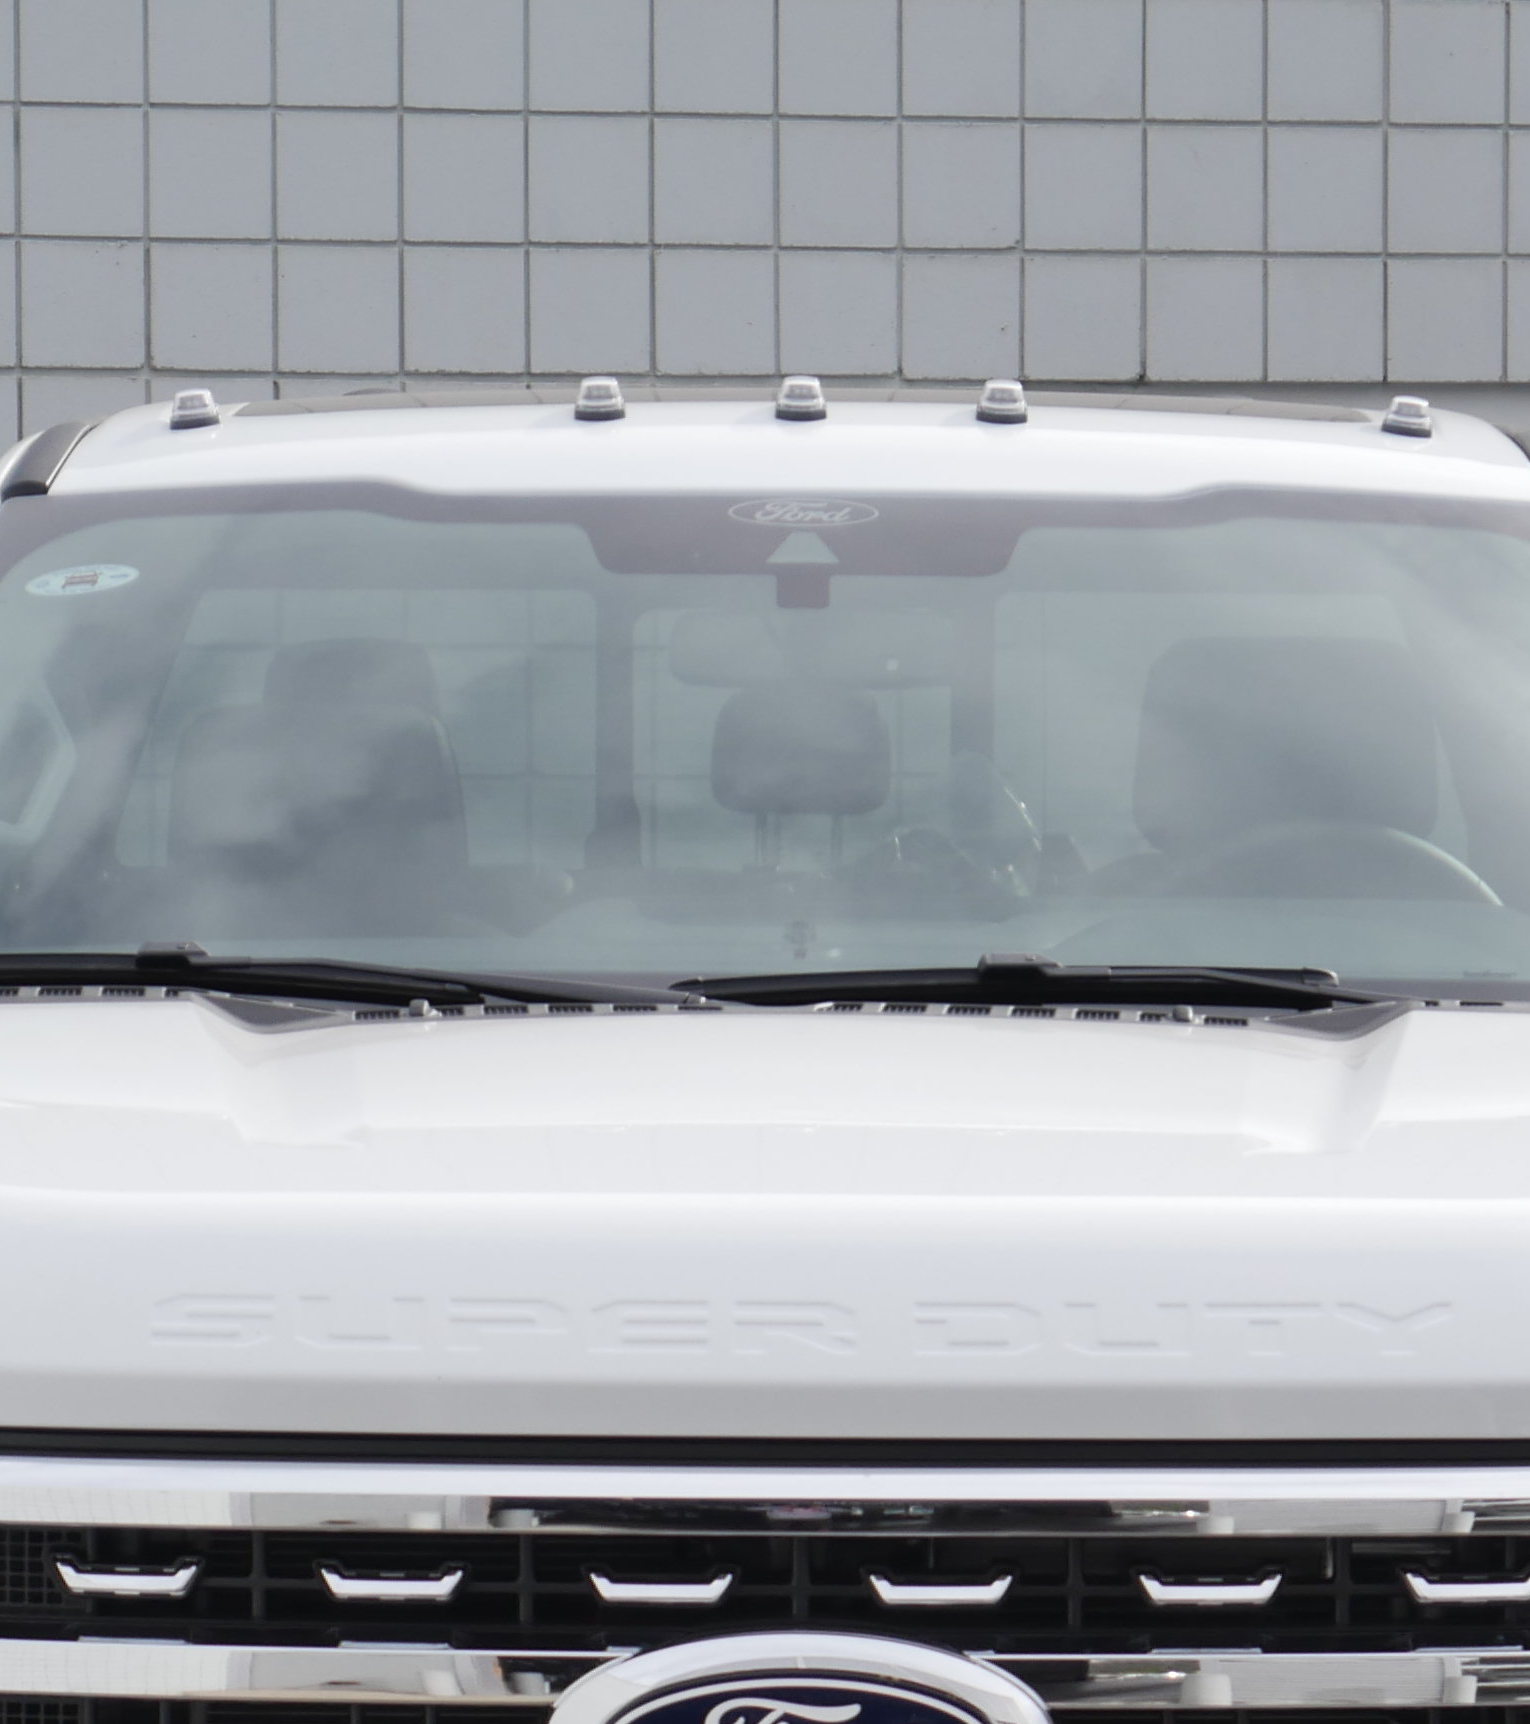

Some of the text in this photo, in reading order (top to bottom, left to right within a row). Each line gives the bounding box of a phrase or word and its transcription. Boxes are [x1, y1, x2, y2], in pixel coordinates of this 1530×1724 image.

[755, 501, 851, 522] Ford
[149, 1293, 1454, 1357] SUPER DUTY
